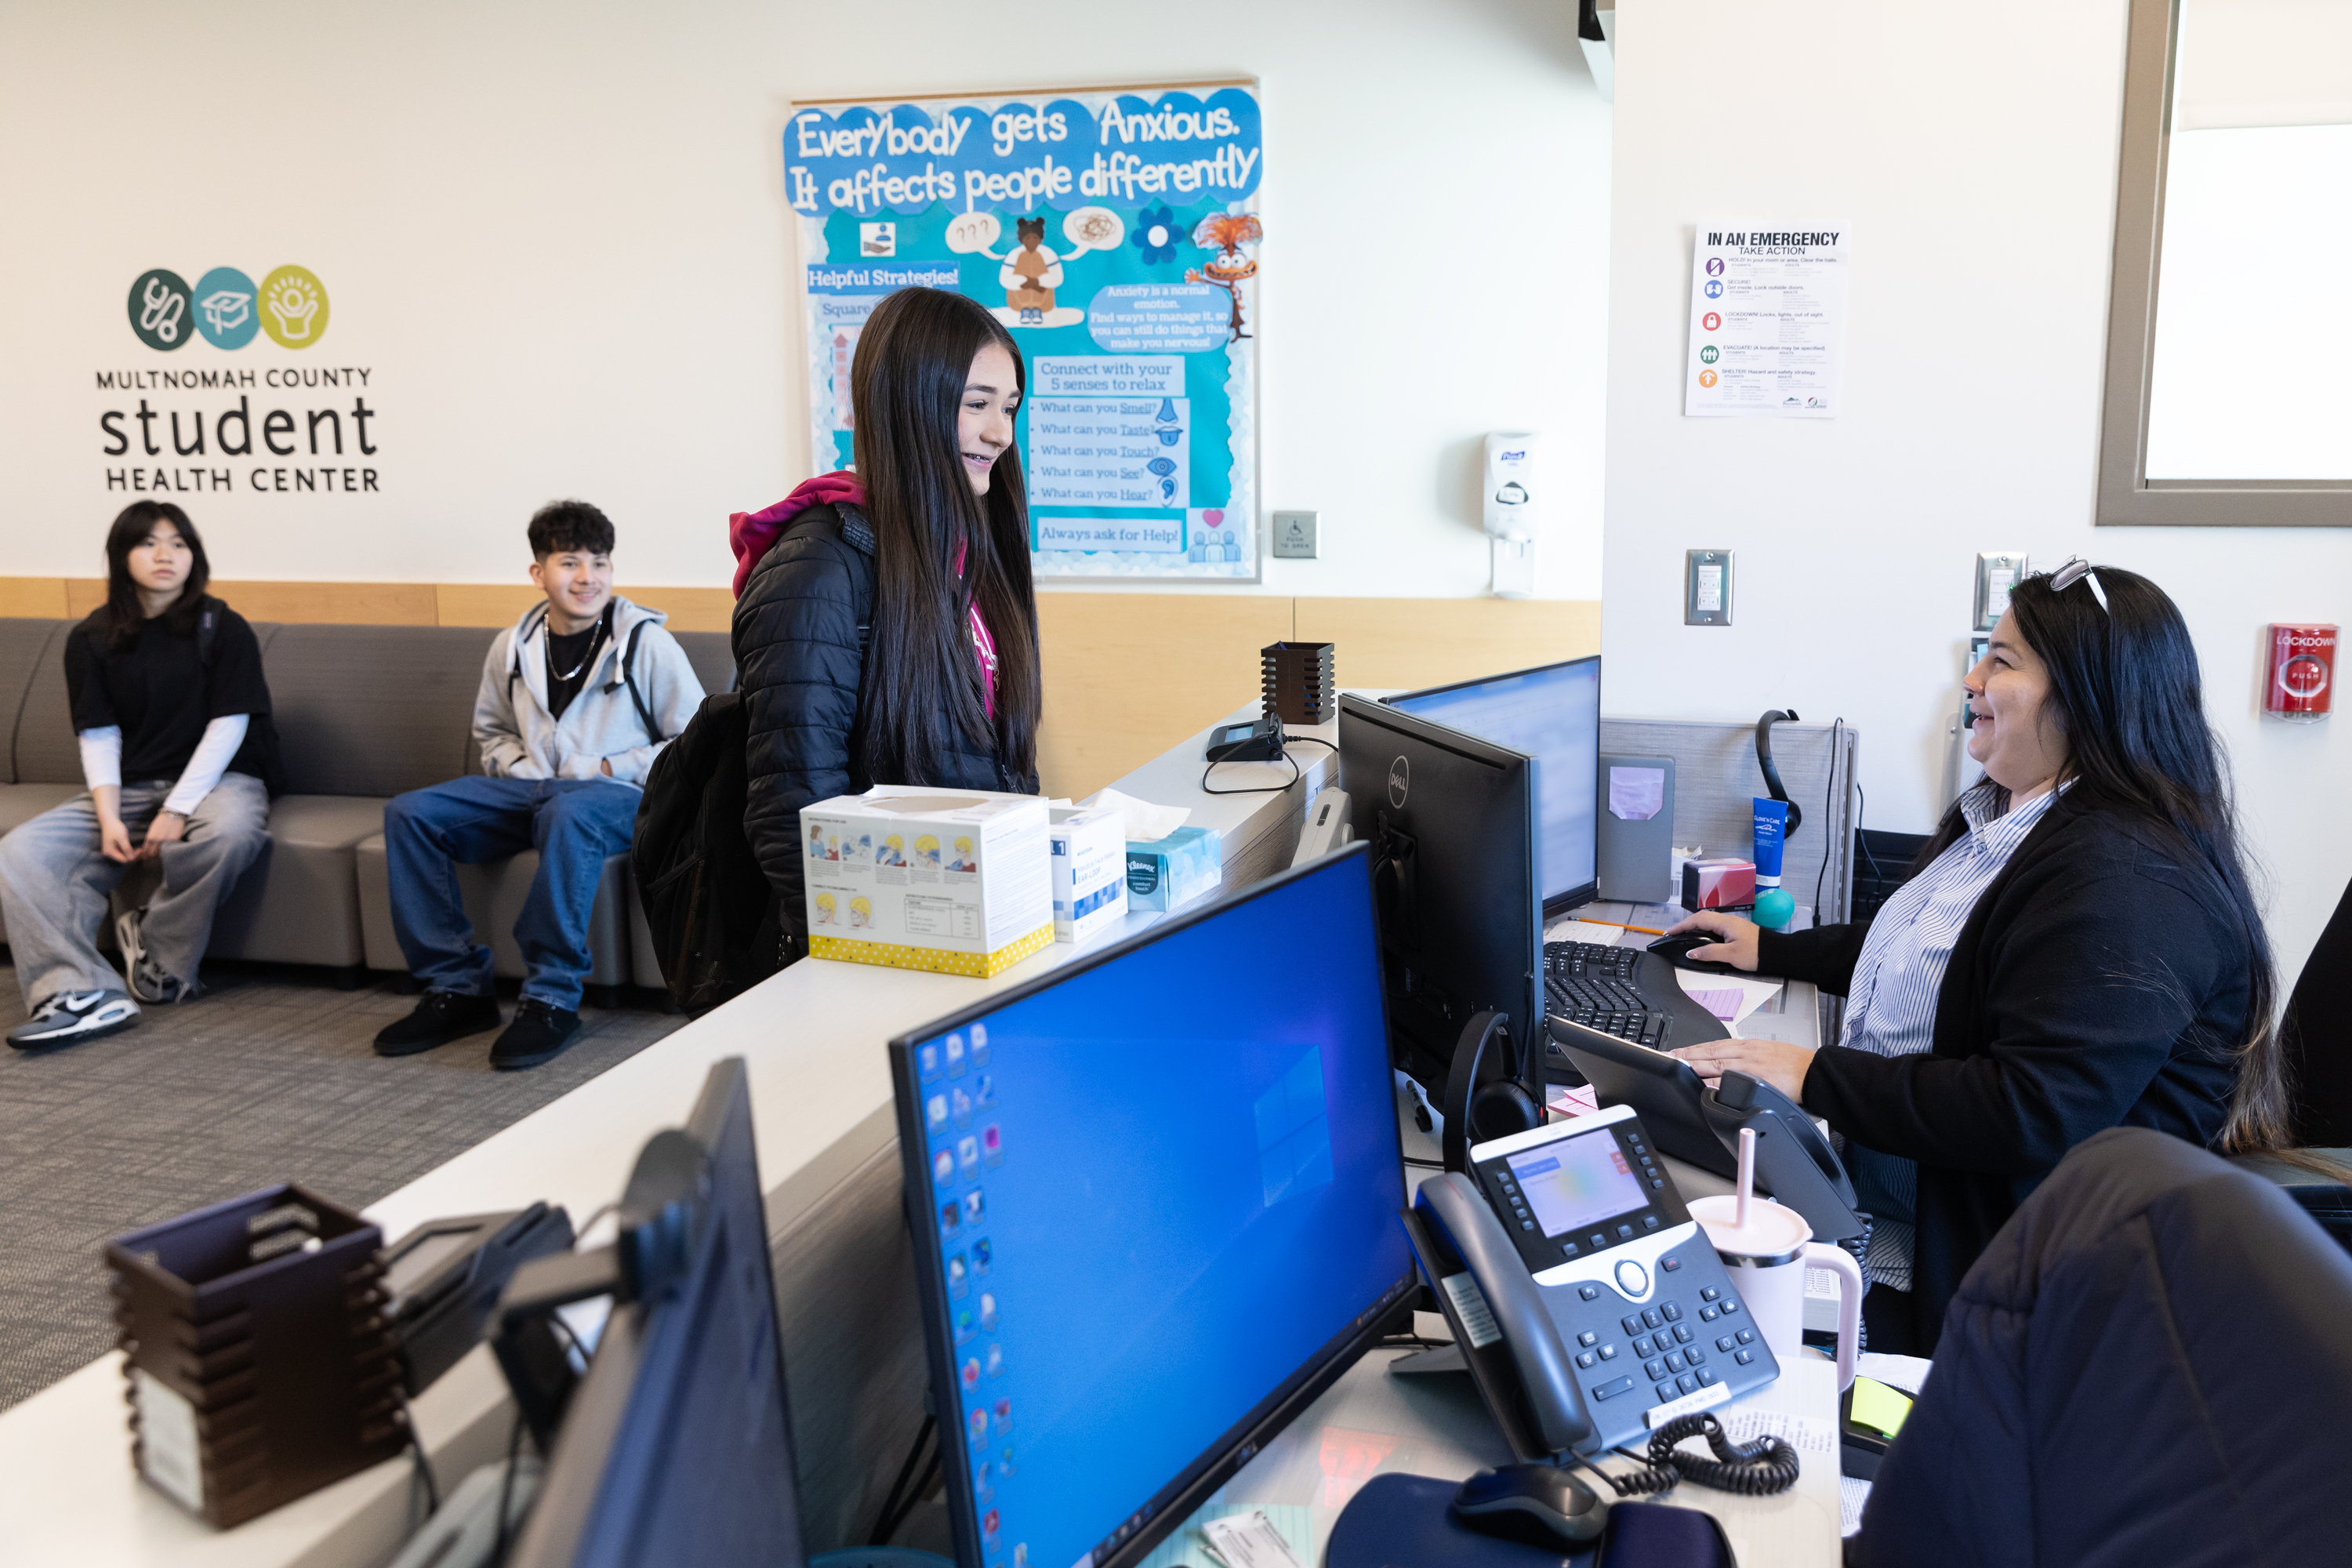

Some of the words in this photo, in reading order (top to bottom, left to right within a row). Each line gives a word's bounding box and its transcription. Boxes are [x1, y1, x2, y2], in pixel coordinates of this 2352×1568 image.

[797, 112, 971, 158] Everybody
[991, 104, 1067, 156] gets
[1101, 100, 1240, 145] Anxious.
[789, 165, 818, 210] It
[829, 162, 956, 212] affects
[964, 154, 1072, 212] people
[1079, 143, 1259, 200] differently
[1708, 232, 1722, 245] IN
[1726, 232, 1745, 245] AN
[1750, 232, 1839, 246] EMERGENCY
[809, 270, 869, 289] Helpful
[873, 268, 959, 288] Strategies!
[1107, 285, 1149, 298] Anxiety
[1151, 285, 1159, 296] is
[1171, 285, 1210, 296] normal
[824, 303, 871, 318] Square
[1134, 299, 1180, 309] emotion.
[1091, 311, 1115, 322] Find
[1117, 314, 1144, 325] ways
[1146, 313, 1157, 322] to
[1159, 313, 1201, 324] manage
[1090, 325, 1111, 337] you
[1112, 325, 1131, 335] can
[1134, 325, 1153, 335] still
[1156, 324, 1169, 335] do
[1171, 325, 1204, 337] things
[1206, 323, 1228, 334] that
[1110, 337, 1138, 348] make
[1140, 339, 1162, 350] you
[1164, 337, 1210, 347] nervous!
[1040, 363, 1098, 376] Connect
[1103, 362, 1134, 376] with
[1138, 365, 1172, 379] your
[96, 370, 256, 389] MULTNOMAH
[267, 368, 372, 387] COUNTY
[1051, 379, 1060, 390] 5
[1063, 380, 1109, 390] senses
[1112, 379, 1126, 390] to
[1130, 378, 1166, 390] relax
[1041, 402, 1070, 413] What
[1096, 405, 1117, 417] you
[1120, 402, 1157, 414] Smell?
[100, 395, 377, 456] student
[1041, 423, 1070, 434] What
[1096, 426, 1117, 438] you
[1041, 445, 1070, 456] What
[1096, 448, 1117, 459] you
[1120, 445, 1160, 456] Touch?
[106, 468, 232, 492] HEALTH
[251, 468, 379, 492] CENTER
[1041, 466, 1070, 477] What
[1096, 469, 1117, 481] you
[1120, 466, 1145, 477] See?
[1041, 487, 1070, 498] What
[1096, 490, 1117, 502] you
[1120, 487, 1152, 499] Hear?
[1041, 528, 1090, 542] Always
[1094, 528, 1116, 540] ask
[1120, 528, 1139, 540] for
[1143, 528, 1178, 543] Help!
[2277, 636, 2336, 647] LOCKDOWN
[1391, 772, 1405, 791] DELL
[1127, 861, 1155, 873] Kleenex
[1650, 1312, 1656, 1320] 2
[1668, 1305, 1675, 1313] 3
[1661, 1334, 1668, 1342] 5
[1680, 1327, 1686, 1335] 6
[1691, 1348, 1698, 1357] 9
[1653, 1363, 1659, 1371] 7
[1672, 1356, 1679, 1364] 8
